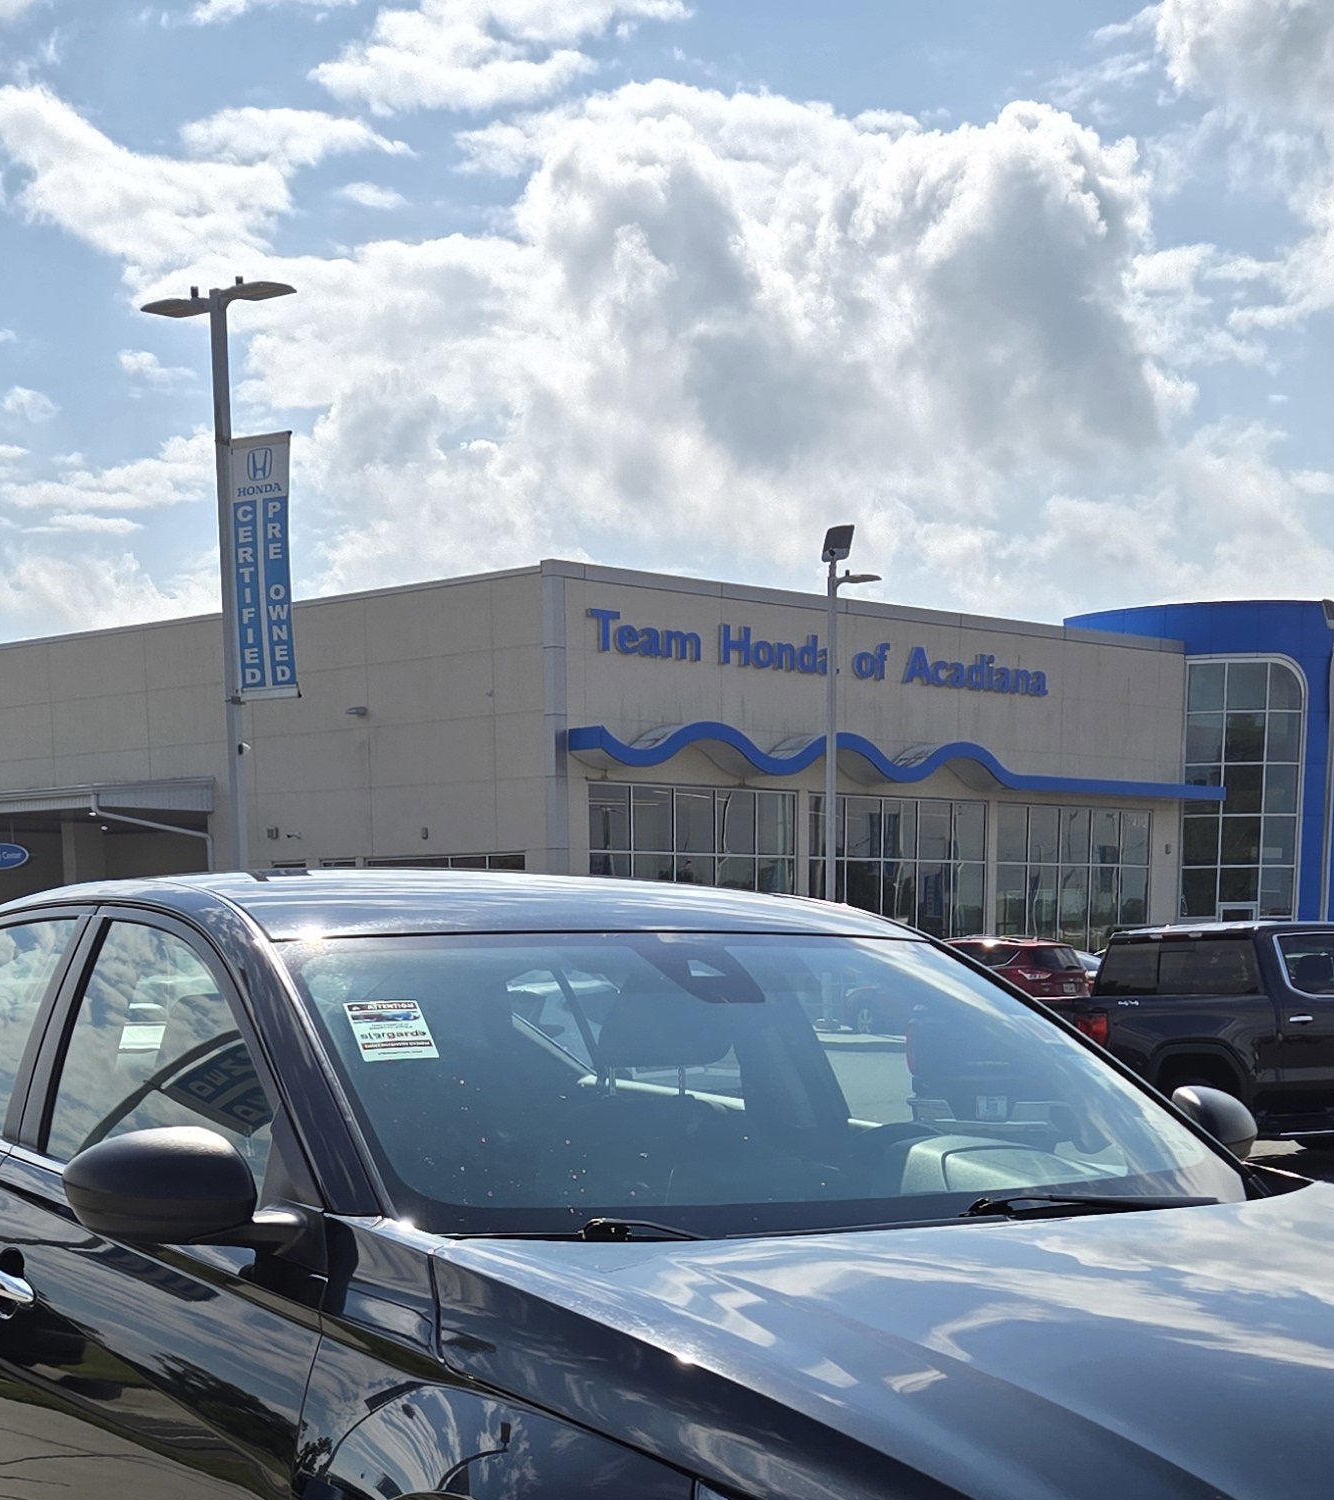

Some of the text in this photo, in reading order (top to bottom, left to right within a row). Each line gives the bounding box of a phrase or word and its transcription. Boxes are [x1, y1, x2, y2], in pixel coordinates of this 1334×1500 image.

[237, 482, 282, 498] HONDA
[236, 505, 261, 685] CERTIFIED
[268, 501, 291, 682] PRE OWNED
[585, 608, 701, 662] Team
[852, 642, 891, 681] of
[901, 646, 1048, 697] Acadiana
[367, 1002, 415, 1010] ATTENTION
